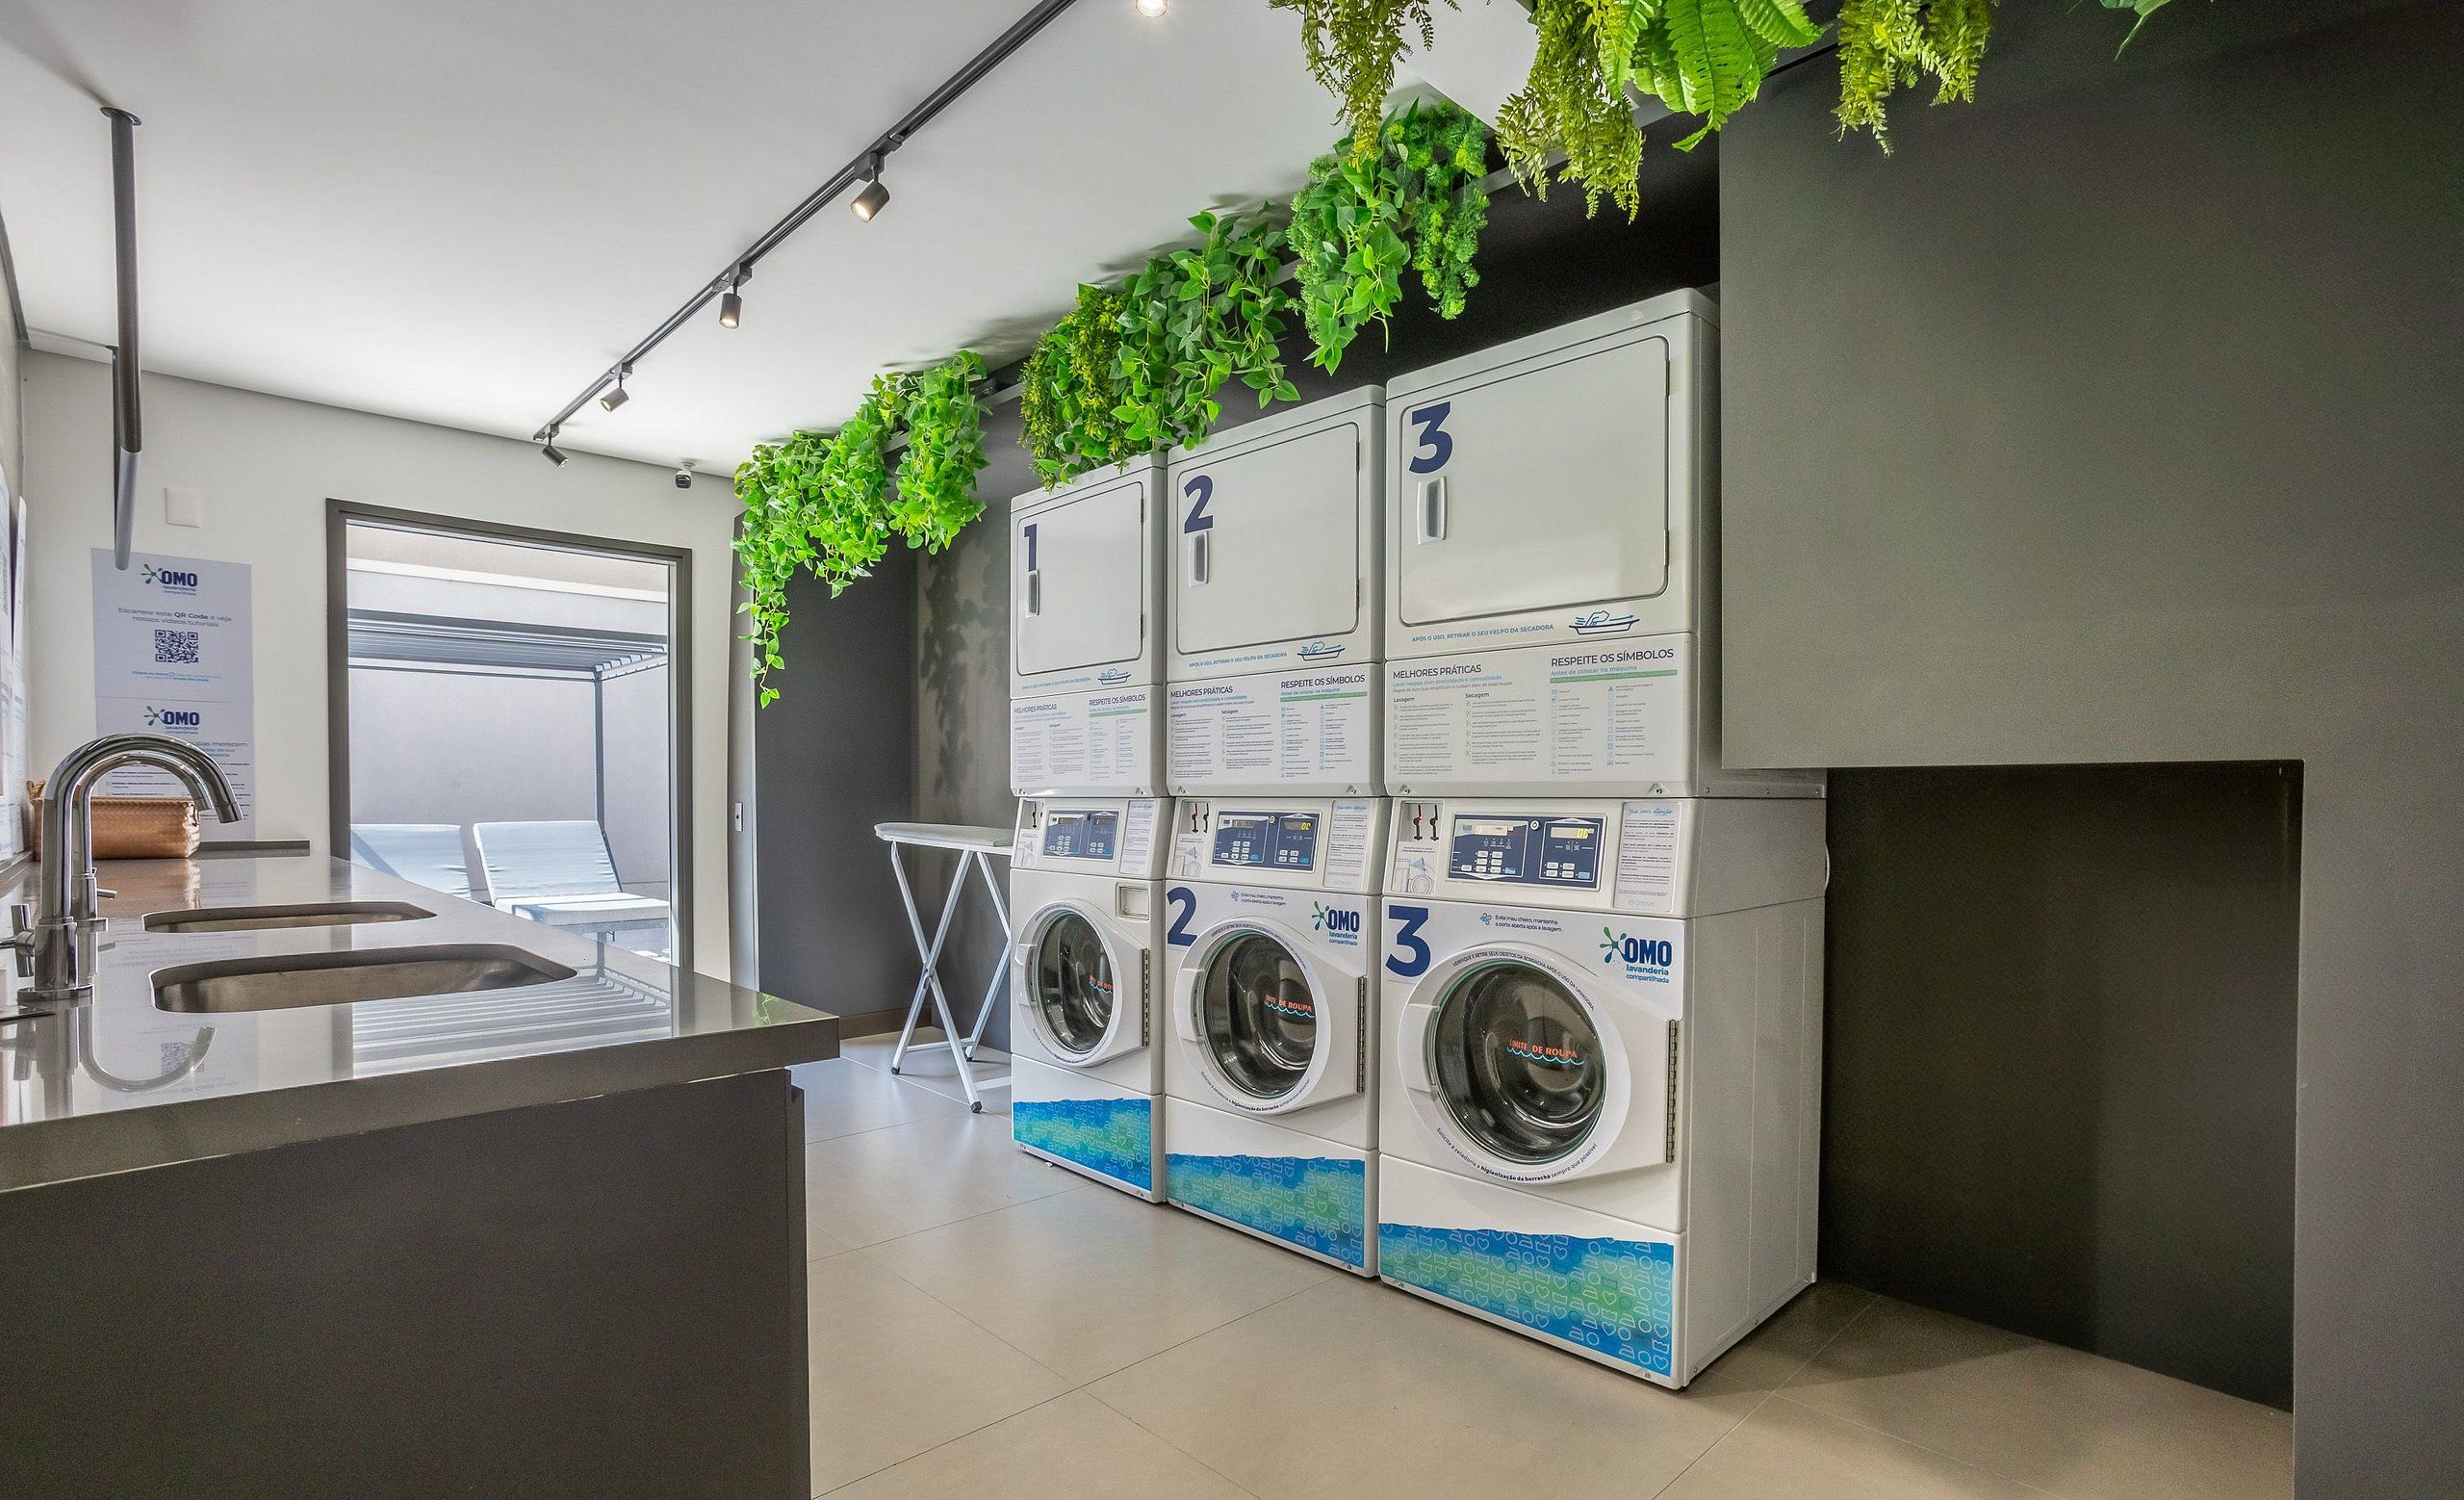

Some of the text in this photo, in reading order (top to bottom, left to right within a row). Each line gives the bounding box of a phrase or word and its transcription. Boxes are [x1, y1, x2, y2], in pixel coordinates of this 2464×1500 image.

[1409, 401, 1453, 475] 3
[1184, 475, 1214, 534] 2
[1024, 524, 1037, 572] 1
[161, 570, 198, 587] OMO
[1551, 648, 1674, 666] RESPEITE OS SÍMBOLOS
[1393, 664, 1482, 680] MELHORES PRÁTICAS
[1281, 679, 1313, 688] RESPEITE
[1325, 674, 1366, 685] SÍMBOLOS
[1170, 685, 1233, 698] MELHORES PRÁTICAS
[1089, 697, 1111, 707] RESPEITE
[164, 711, 200, 726] OMO
[1167, 886, 1198, 947] 2
[1328, 909, 1360, 932] OMO
[1329, 931, 1357, 940] lavanderia
[1386, 905, 1431, 977] 3
[1624, 938, 1673, 967] OMO
[1627, 964, 1669, 975] lavanderia
[1561, 973, 1570, 983] USO
[1570, 980, 1576, 989] DA
[1626, 973, 1669, 983] compartilhada
[1288, 1001, 1312, 1012] ROUPA
[1532, 1045, 1543, 1053] DE
[1545, 1047, 1578, 1058] ROUPA
[1436, 1127, 1452, 1146] Solicite
[1453, 1147, 1476, 1167] zeladoria
[1480, 1165, 1517, 1181] higienização
[1551, 1166, 1571, 1178] sempre
[1570, 1160, 1580, 1169] que
